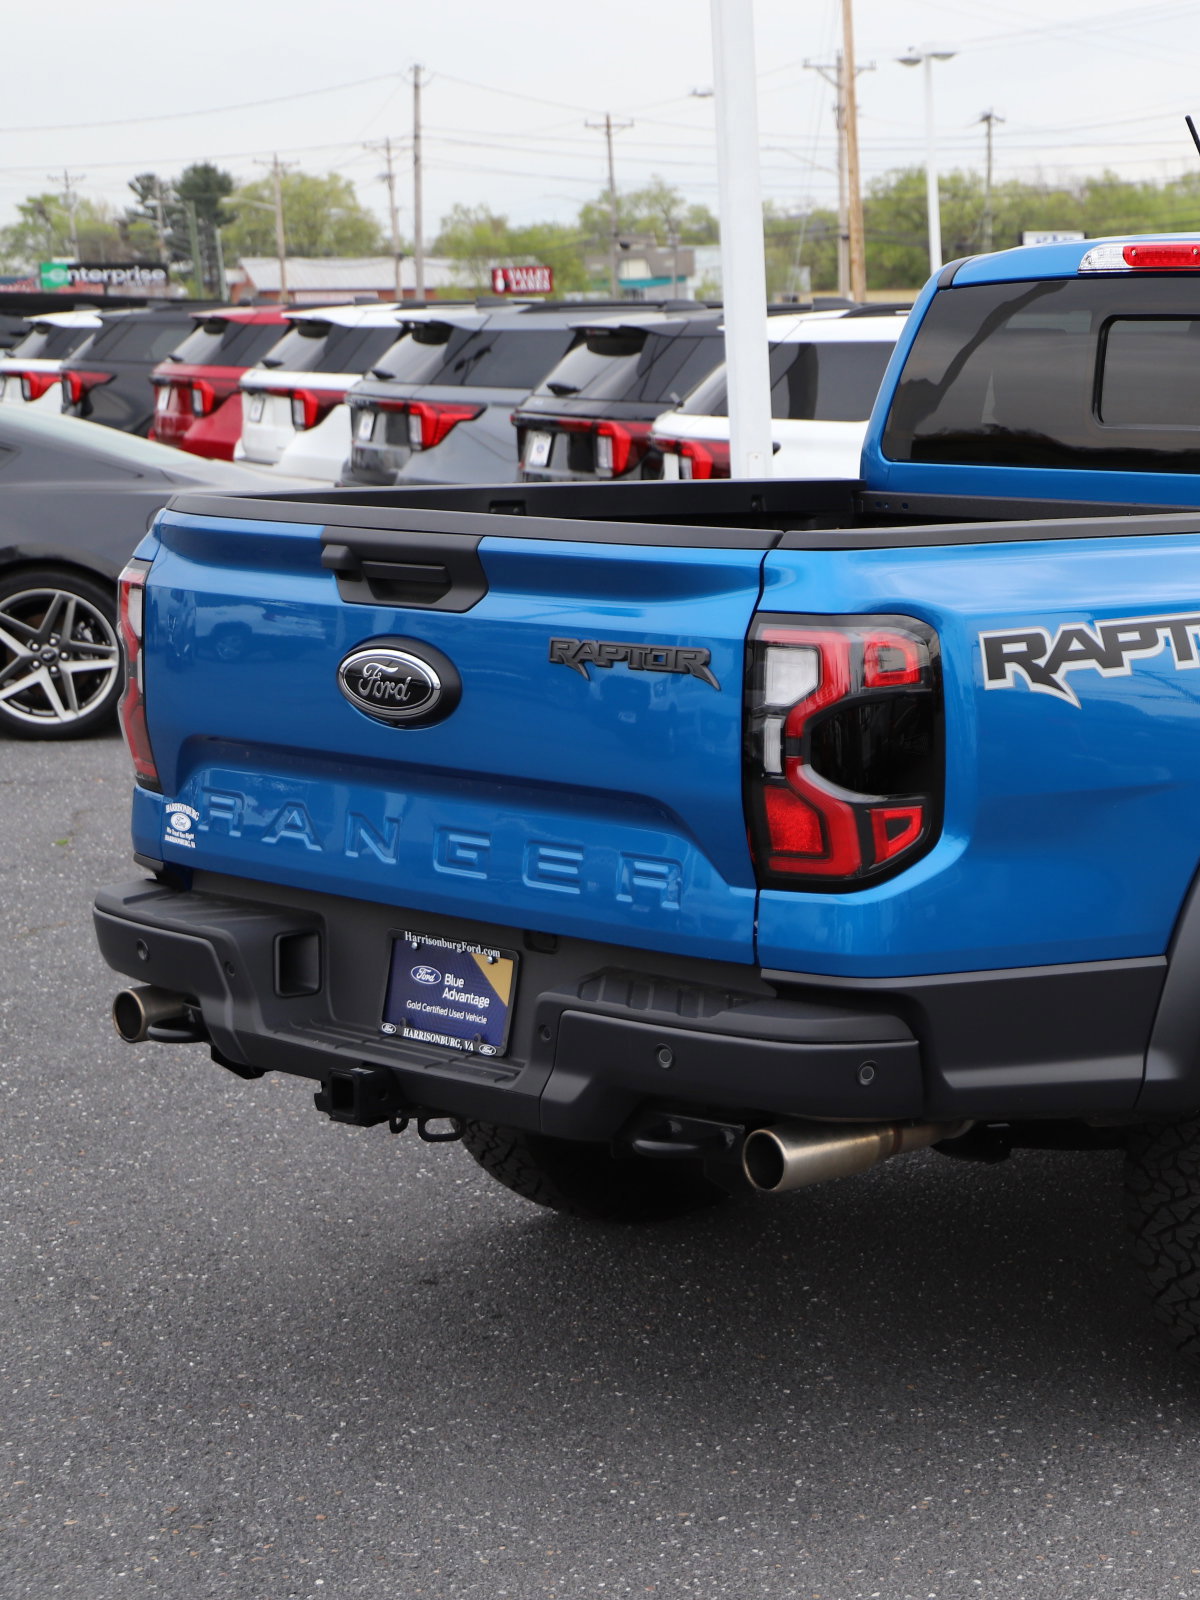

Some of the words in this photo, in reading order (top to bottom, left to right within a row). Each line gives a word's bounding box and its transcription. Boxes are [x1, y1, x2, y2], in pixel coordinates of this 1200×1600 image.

[49, 265, 167, 285] enterprise
[508, 267, 551, 280] VALLEY
[510, 279, 551, 291] LANES
[549, 637, 722, 691] RAPTOR
[358, 662, 413, 701] Ford
[198, 786, 684, 909] RANGER
[404, 931, 501, 957] HarrisonburgFord.com
[416, 968, 436, 982] Ford
[444, 973, 464, 988] Blue
[442, 987, 490, 1008] Advantage
[406, 1000, 421, 1011] Gold
[422, 1003, 448, 1016] Certified
[448, 1008, 464, 1019] Used
[465, 1011, 488, 1024] Vehicle
[402, 1028, 463, 1051] HARRISONBURG,
[464, 1041, 474, 1052] VA
